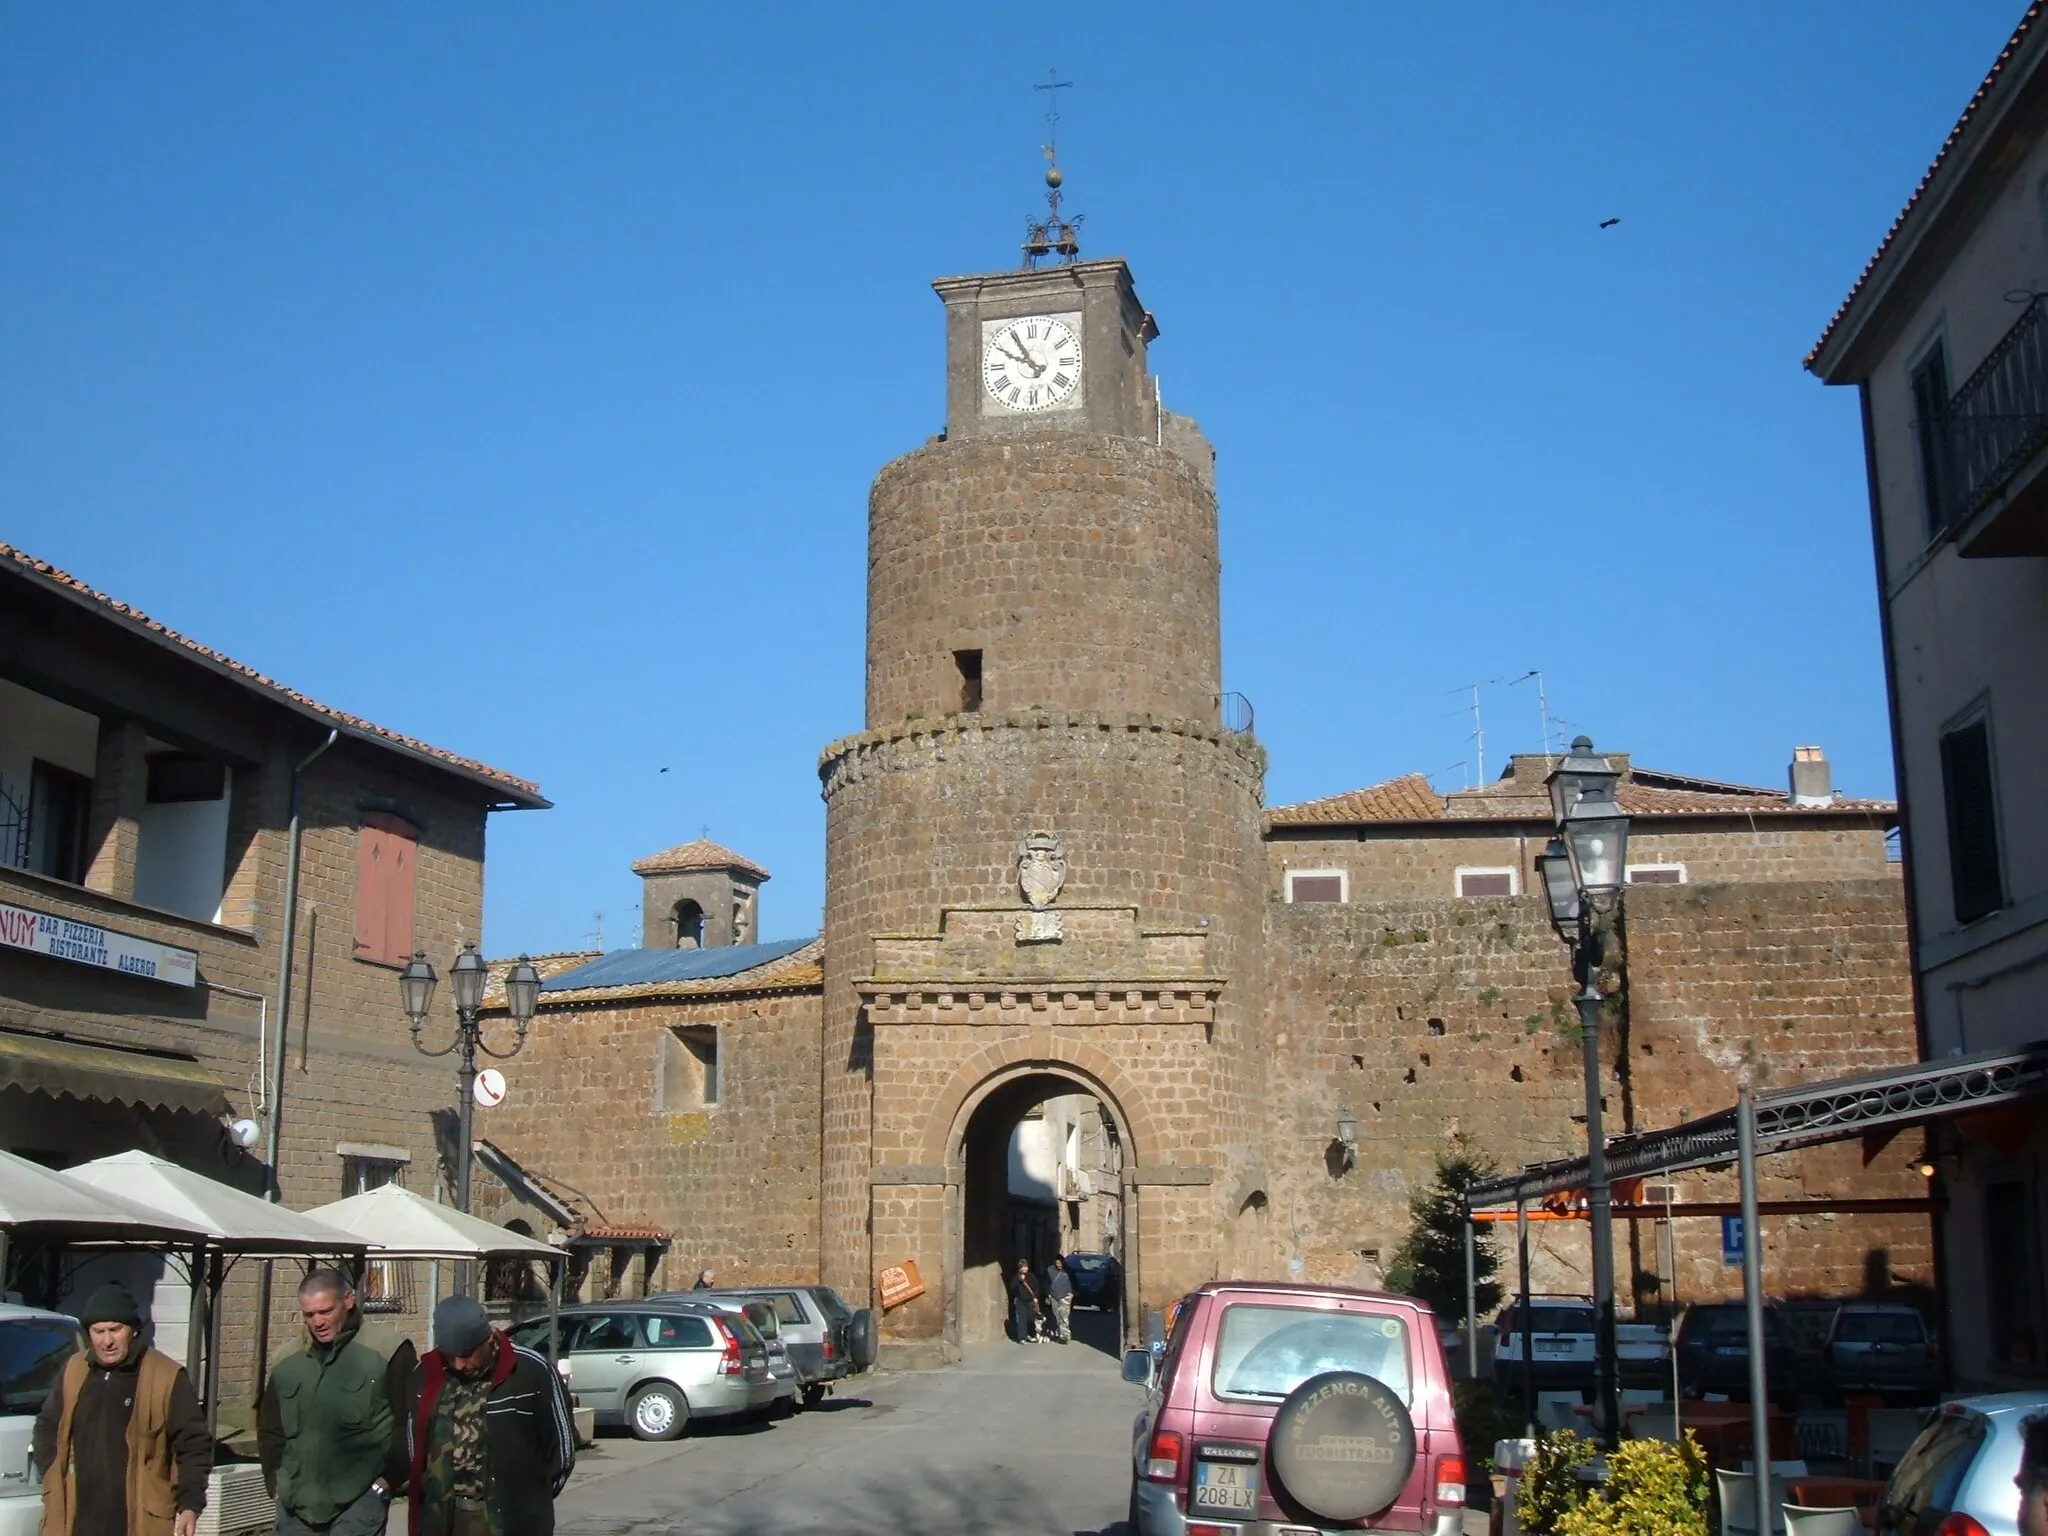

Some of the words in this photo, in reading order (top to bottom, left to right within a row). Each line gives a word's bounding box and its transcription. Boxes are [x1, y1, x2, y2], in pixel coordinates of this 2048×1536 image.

[39, 916, 58, 934] BAR
[63, 922, 105, 947] PIZZERIA
[50, 938, 109, 965] RISTORANTE
[118, 954, 156, 976] ALBERGO
[1371, 1397, 1401, 1443] AUTO
[1298, 1446, 1391, 1461] FUORISTRADA
[1217, 1467, 1236, 1485] ZA
[1198, 1486, 1228, 1505] 208
[1233, 1490, 1253, 1509] LX
